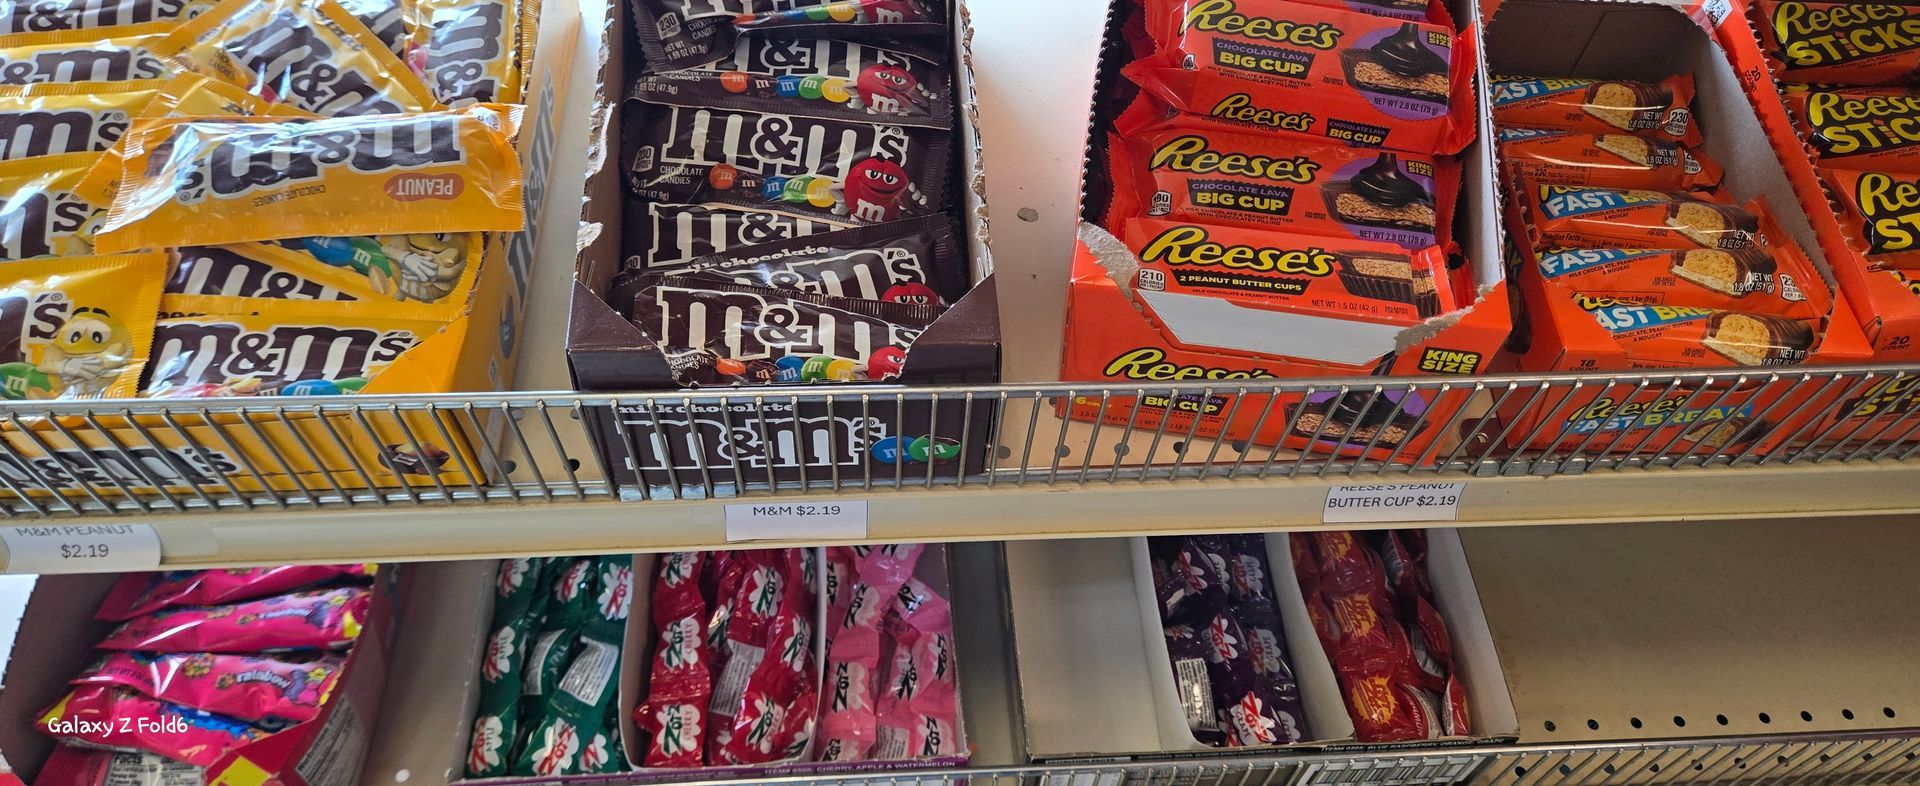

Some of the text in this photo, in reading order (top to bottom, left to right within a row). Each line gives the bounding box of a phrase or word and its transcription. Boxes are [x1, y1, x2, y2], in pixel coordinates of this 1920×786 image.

[658, 15, 677, 32] 230
[1179, 0, 1341, 49] Reese's
[1216, 42, 1309, 62] CHOCOLATE LAVA
[1219, 52, 1305, 75] BIG CUP
[1750, 65, 1762, 81] 20
[1211, 94, 1314, 132] Reese's
[1373, 97, 1386, 105] NET
[1387, 99, 1398, 108] WT
[1410, 103, 1419, 112] OZ
[1420, 104, 1431, 114] (79
[1431, 106, 1439, 116] g)
[1671, 111, 1688, 123] 230
[1329, 121, 1387, 135] CHOCOLATE LAVA
[1329, 128, 1382, 144] BIG CUP
[1152, 137, 1318, 182] Reese's
[1407, 161, 1433, 172] KING
[659, 165, 704, 176] CHOCOLATE
[1408, 167, 1434, 178] SIZE
[396, 177, 455, 196] PEANUT
[1191, 183, 1289, 198] CHOCOLATE LAVA
[252, 184, 326, 207] CHOCOLATE CANDIES
[1196, 192, 1286, 211] BIG CUP
[1547, 190, 1616, 217] FAST
[1359, 229, 1371, 238] NET
[1373, 231, 1384, 239] WT
[1385, 232, 1396, 240] 2.8
[1399, 234, 1408, 243] OZ
[1419, 236, 1427, 246] g)
[1142, 227, 1335, 276] Reese's
[1541, 249, 1619, 275] FAST
[1607, 264, 1631, 274] NOUGAT
[1141, 270, 1163, 282] 210
[1188, 276, 1230, 285] PEANUT
[1232, 279, 1272, 288] BUTTER
[1274, 283, 1302, 291] CUPS
[1750, 273, 1774, 283] NET WT
[1311, 299, 1325, 307] NET
[1325, 300, 1336, 308] WT
[1338, 301, 1348, 310] 1.5
[1349, 303, 1358, 311] OZ
[1359, 303, 1370, 312] (42
[1370, 305, 1378, 314] g)
[1650, 325, 1672, 334] PEANUT
[1672, 321, 1694, 330] BUTTER
[1638, 332, 1663, 342] NOUGAT
[1889, 336, 1911, 345] 20
[1426, 349, 1479, 364] KING
[1779, 349, 1806, 359] NET WT
[1421, 360, 1474, 374] SIZE
[1578, 359, 1596, 368] 18
[1328, 495, 1456, 508] BUTTER CUP $2.19
[753, 504, 841, 517] M&M $2.19
[15, 524, 135, 537] M&M PEANUT
[61, 543, 109, 559] $2.19
[1262, 635, 1275, 661] GRAPE
[235, 668, 291, 690] rainbow
[683, 710, 694, 741] CHERRY
[1235, 711, 1250, 737] GRAPE
[1367, 743, 1390, 751] BLUE
